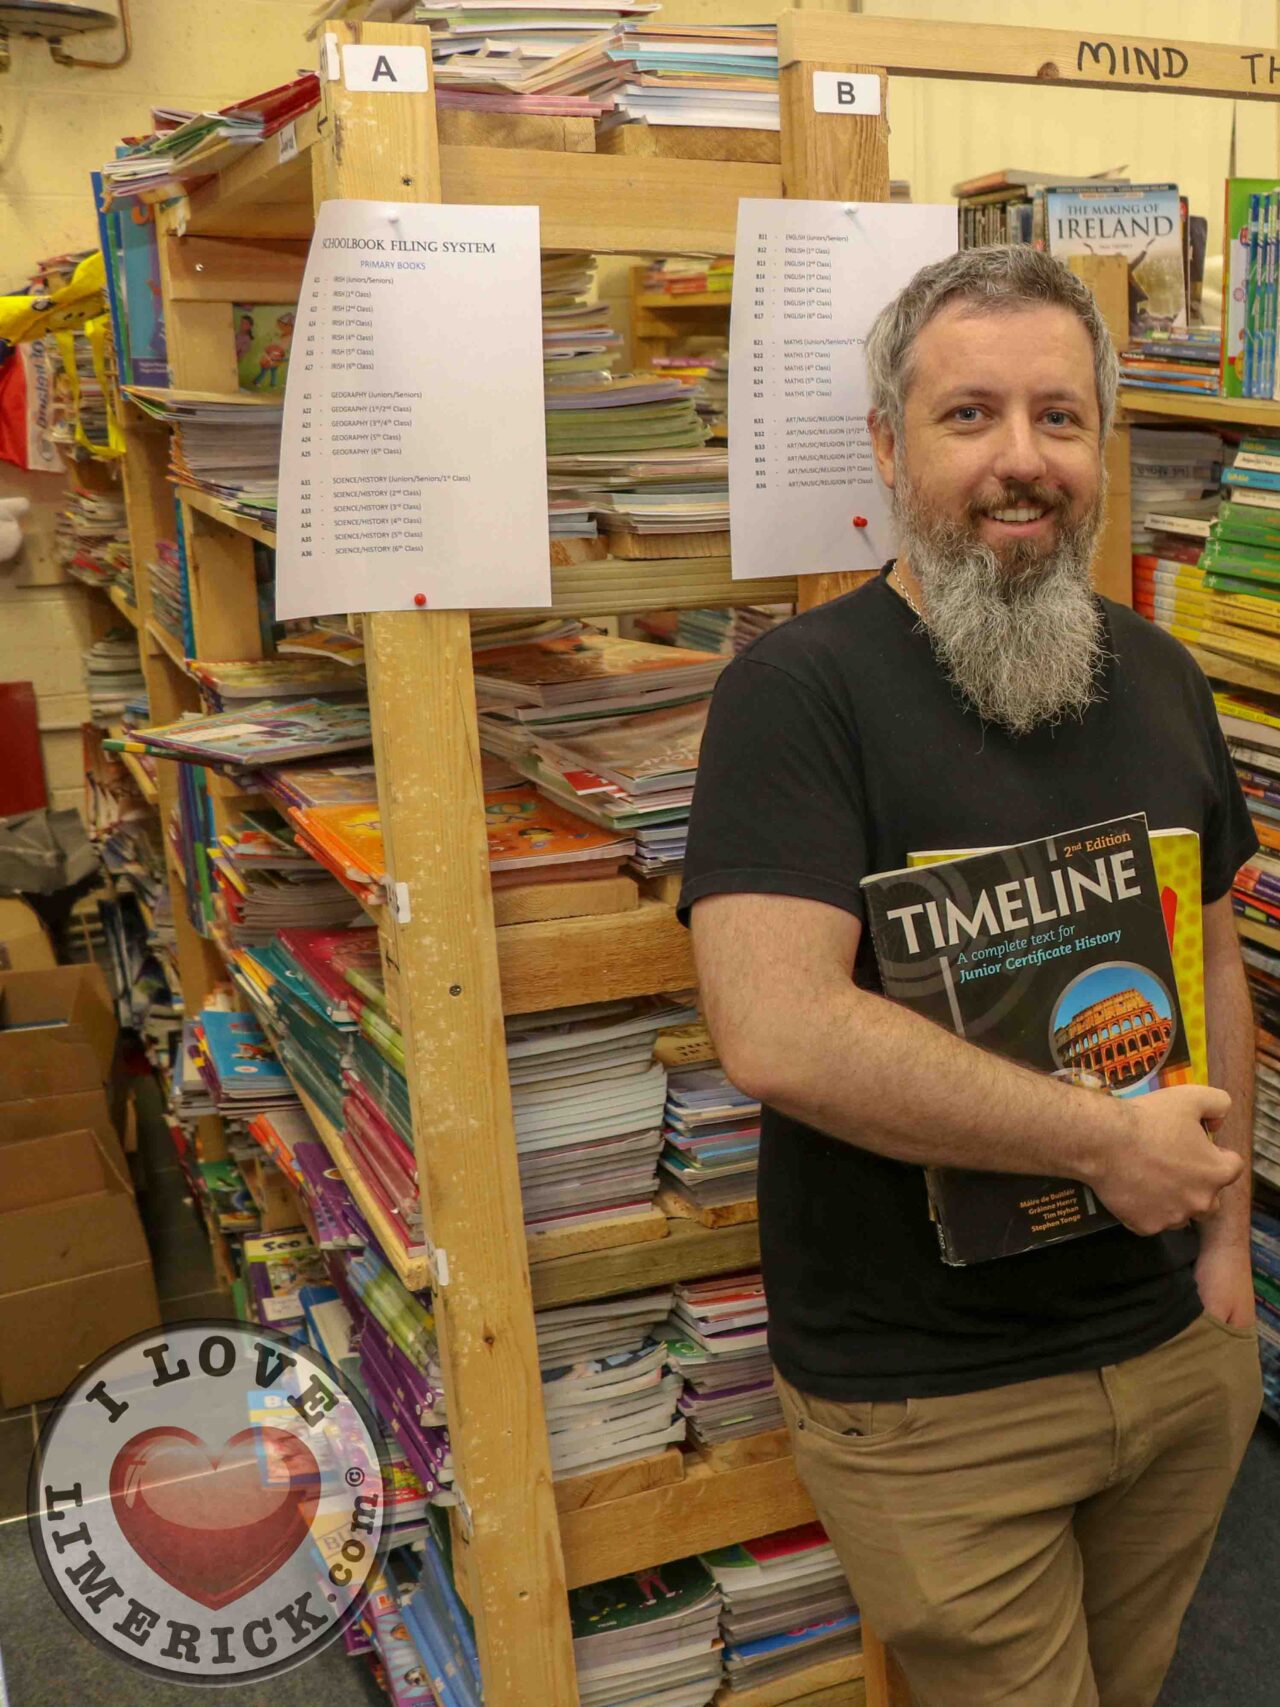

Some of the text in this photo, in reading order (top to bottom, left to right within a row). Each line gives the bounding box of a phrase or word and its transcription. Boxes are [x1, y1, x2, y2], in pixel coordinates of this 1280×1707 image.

[1077, 41, 1188, 80] MIND
[372, 56, 397, 82] A
[837, 81, 855, 104] B
[1068, 204, 1159, 215] THE MAKING OF
[1057, 216, 1173, 239] IRELAND
[322, 238, 495, 253] SCHOOLBOOK FILING SYSTEM
[360, 260, 426, 270] PRIMARY BOOKS
[333, 476, 387, 484] SCIENCE/HISTORY
[333, 490, 387, 498] SCIENCE/HISTORY
[334, 504, 388, 512] SCIENCE/HISTORY
[334, 518, 389, 527] SCIENCE/HISTORY
[335, 532, 390, 540] SCIENCE/HISTORY
[336, 546, 391, 555] SCIENCE/HISTORY
[1064, 831, 1131, 858] 2nd Edition
[886, 850, 1141, 954] TIMELINE
[957, 924, 1075, 965] A complete text for
[960, 929, 1122, 984] Junior Certificate History
[1041, 1195, 1049, 1203] de
[1057, 1198, 1078, 1209] Henry
[1043, 1206, 1079, 1220] Tim Nyhan
[1032, 1214, 1081, 1232] Stephen Tonge
